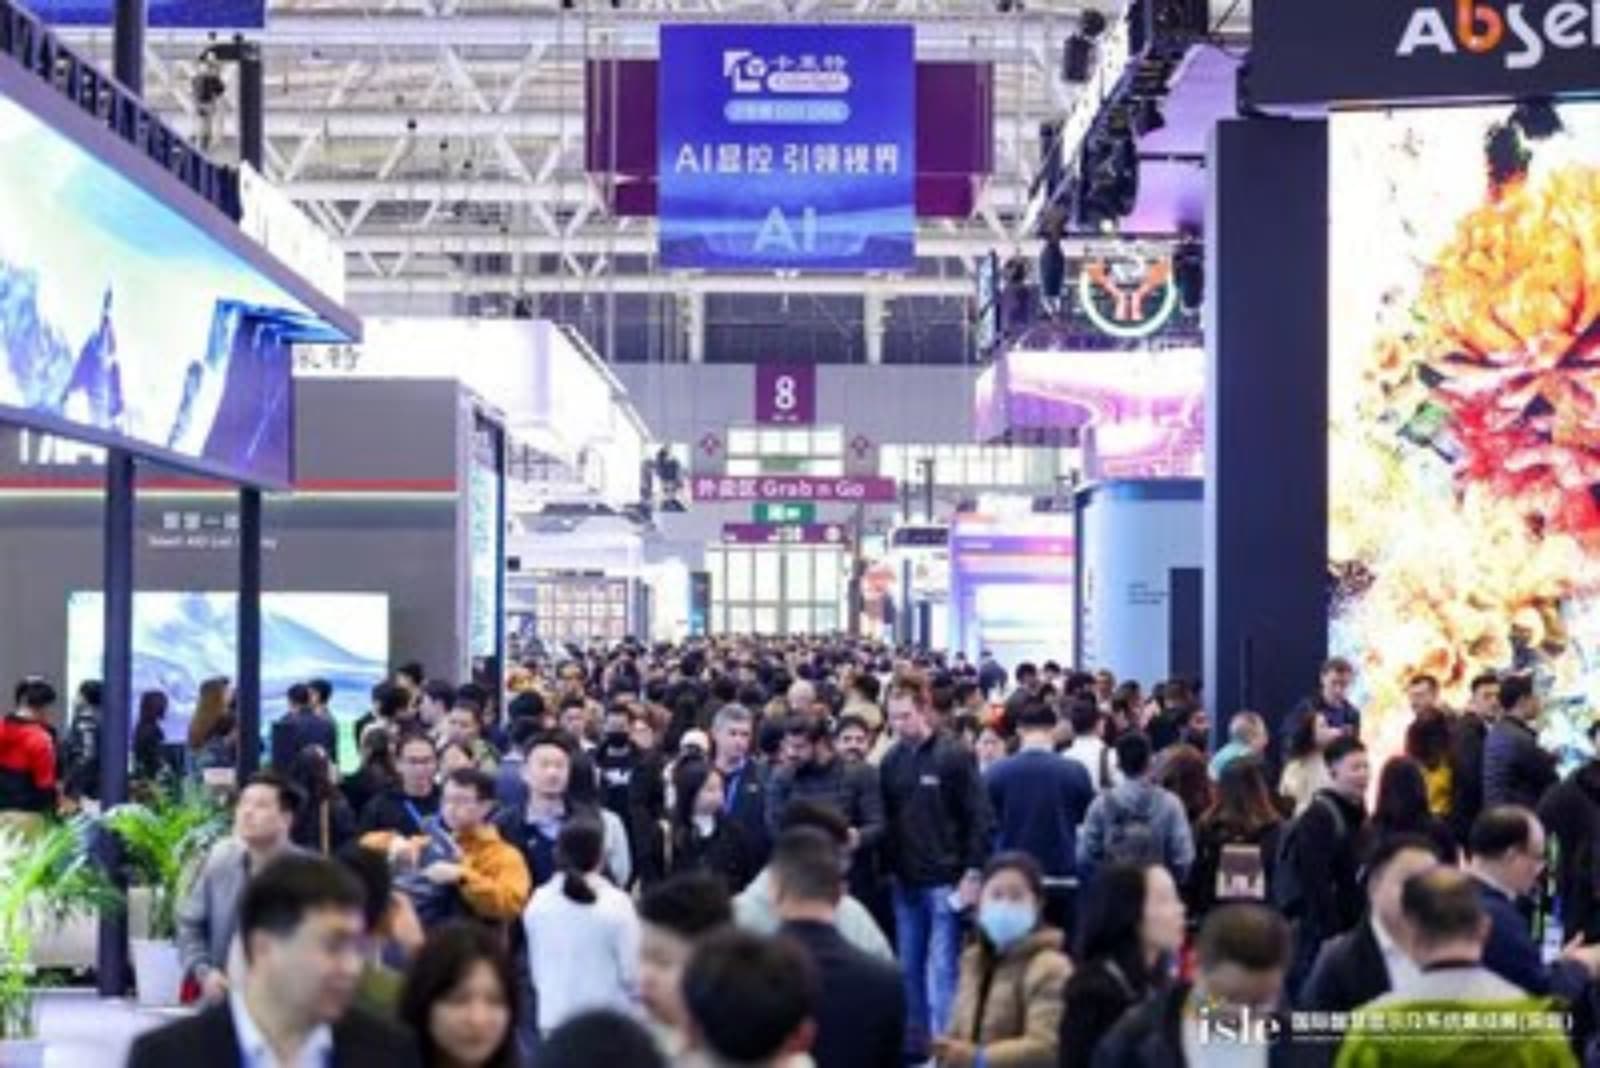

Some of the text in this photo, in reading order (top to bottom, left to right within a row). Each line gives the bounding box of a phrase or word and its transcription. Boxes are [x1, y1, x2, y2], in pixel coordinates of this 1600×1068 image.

[753, 206, 818, 253] AI
[774, 374, 798, 410] 8
[762, 478, 815, 499] Grab
[834, 478, 866, 498] Go
